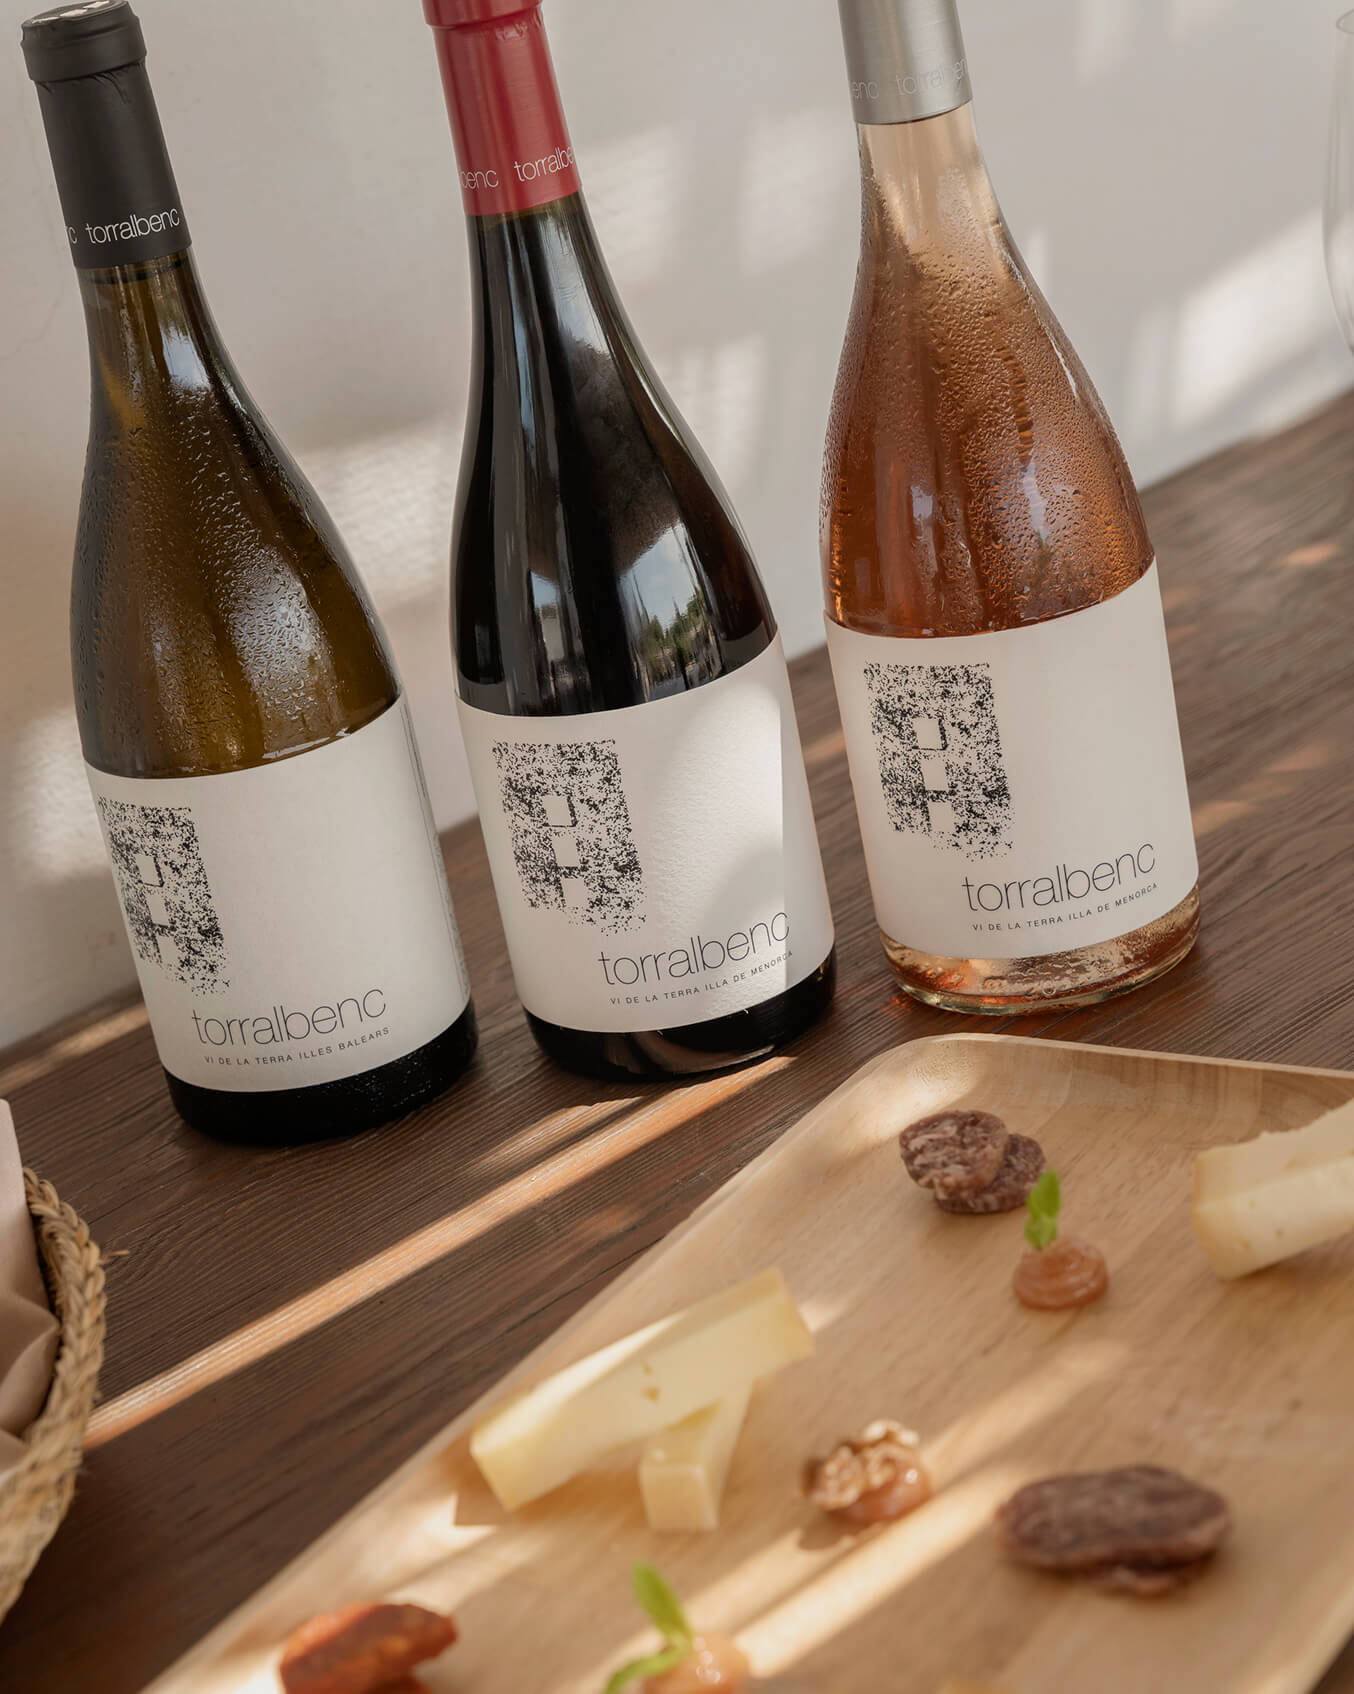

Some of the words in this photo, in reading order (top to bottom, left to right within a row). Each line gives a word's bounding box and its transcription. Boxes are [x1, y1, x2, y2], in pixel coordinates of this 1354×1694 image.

[85, 208, 180, 244] torralbenc
[961, 843, 1156, 912] torralbenc
[972, 923, 983, 932] VI
[988, 923, 1002, 931] DE
[1007, 921, 1022, 931] LA
[1027, 915, 1064, 928] TERRA
[1068, 908, 1093, 921] ILLA
[1097, 902, 1111, 913] DE
[1115, 882, 1158, 907] MENORCA
[597, 911, 790, 986] torralbenc
[610, 997, 621, 1005] VI
[626, 996, 640, 1004] DE
[645, 993, 660, 1002] LA
[664, 986, 701, 1000] TERRA
[704, 979, 729, 992] ILLA
[733, 972, 747, 983] DE
[750, 950, 794, 977] MENORCA
[192, 988, 386, 1046] torralbenc
[205, 1056, 214, 1064] VI
[218, 1056, 232, 1065] DE
[236, 1057, 250, 1065] LA
[256, 1054, 294, 1065] TERRA
[299, 1046, 334, 1060] ILLES
[338, 1026, 390, 1050] BALEARS
